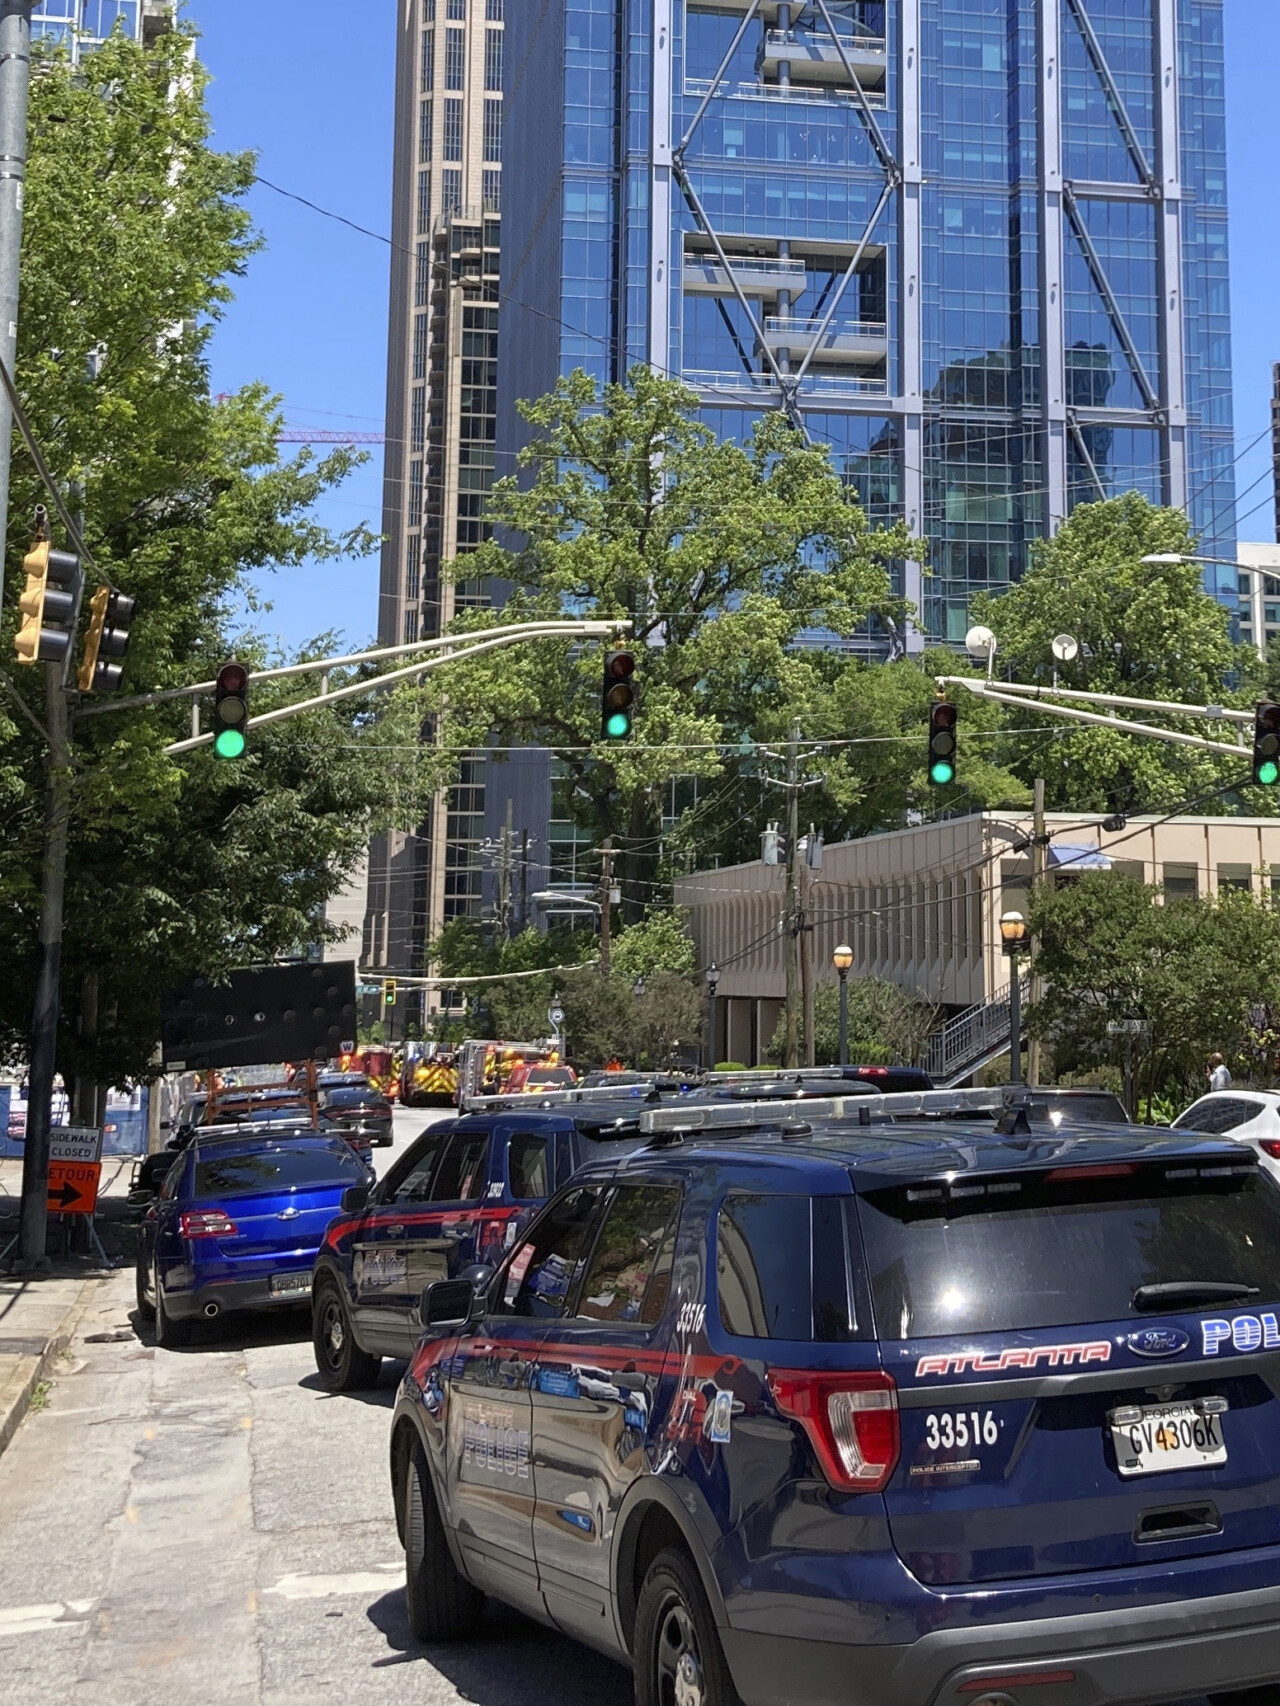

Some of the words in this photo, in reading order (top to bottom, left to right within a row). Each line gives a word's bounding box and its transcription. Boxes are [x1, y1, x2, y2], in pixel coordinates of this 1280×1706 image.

[50, 1133, 98, 1144] SIDEWALK
[51, 1147, 91, 1157] CLOSED
[49, 1167, 95, 1180] ETOUR
[676, 1302, 707, 1333] 33516
[1144, 1332, 1177, 1350] Ford
[915, 1340, 1112, 1377] ATLANTA
[682, 1390, 697, 1401] DIAL
[1144, 1404, 1193, 1420] EORGIA
[926, 1410, 998, 1449] 33516
[1130, 1414, 1218, 1455] GV4306K
[464, 1420, 529, 1479] POLICE
